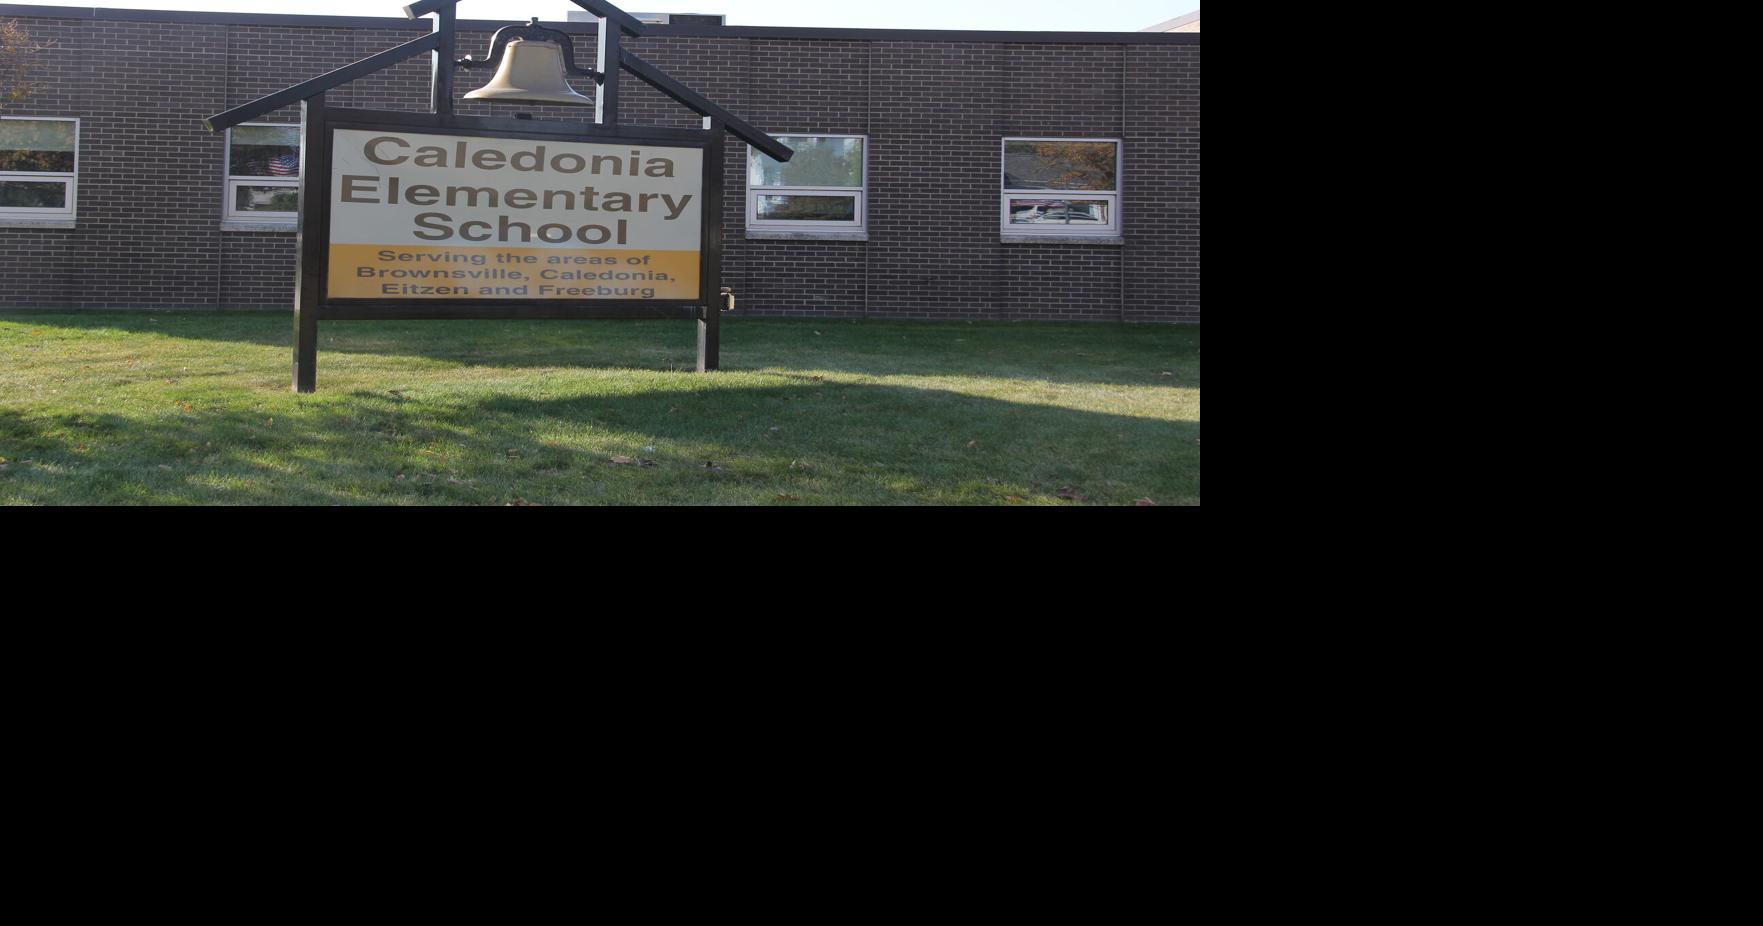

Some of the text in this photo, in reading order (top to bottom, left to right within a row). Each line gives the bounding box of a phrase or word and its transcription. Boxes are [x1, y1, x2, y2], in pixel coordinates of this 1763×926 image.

[363, 136, 675, 178] Caledonia
[340, 174, 693, 220] Elementary
[413, 212, 627, 245] School
[378, 250, 652, 265] Serving the areas of
[356, 266, 676, 282] Brownsville, Caledonia,
[381, 283, 655, 298] Eitzen and Freeburg
